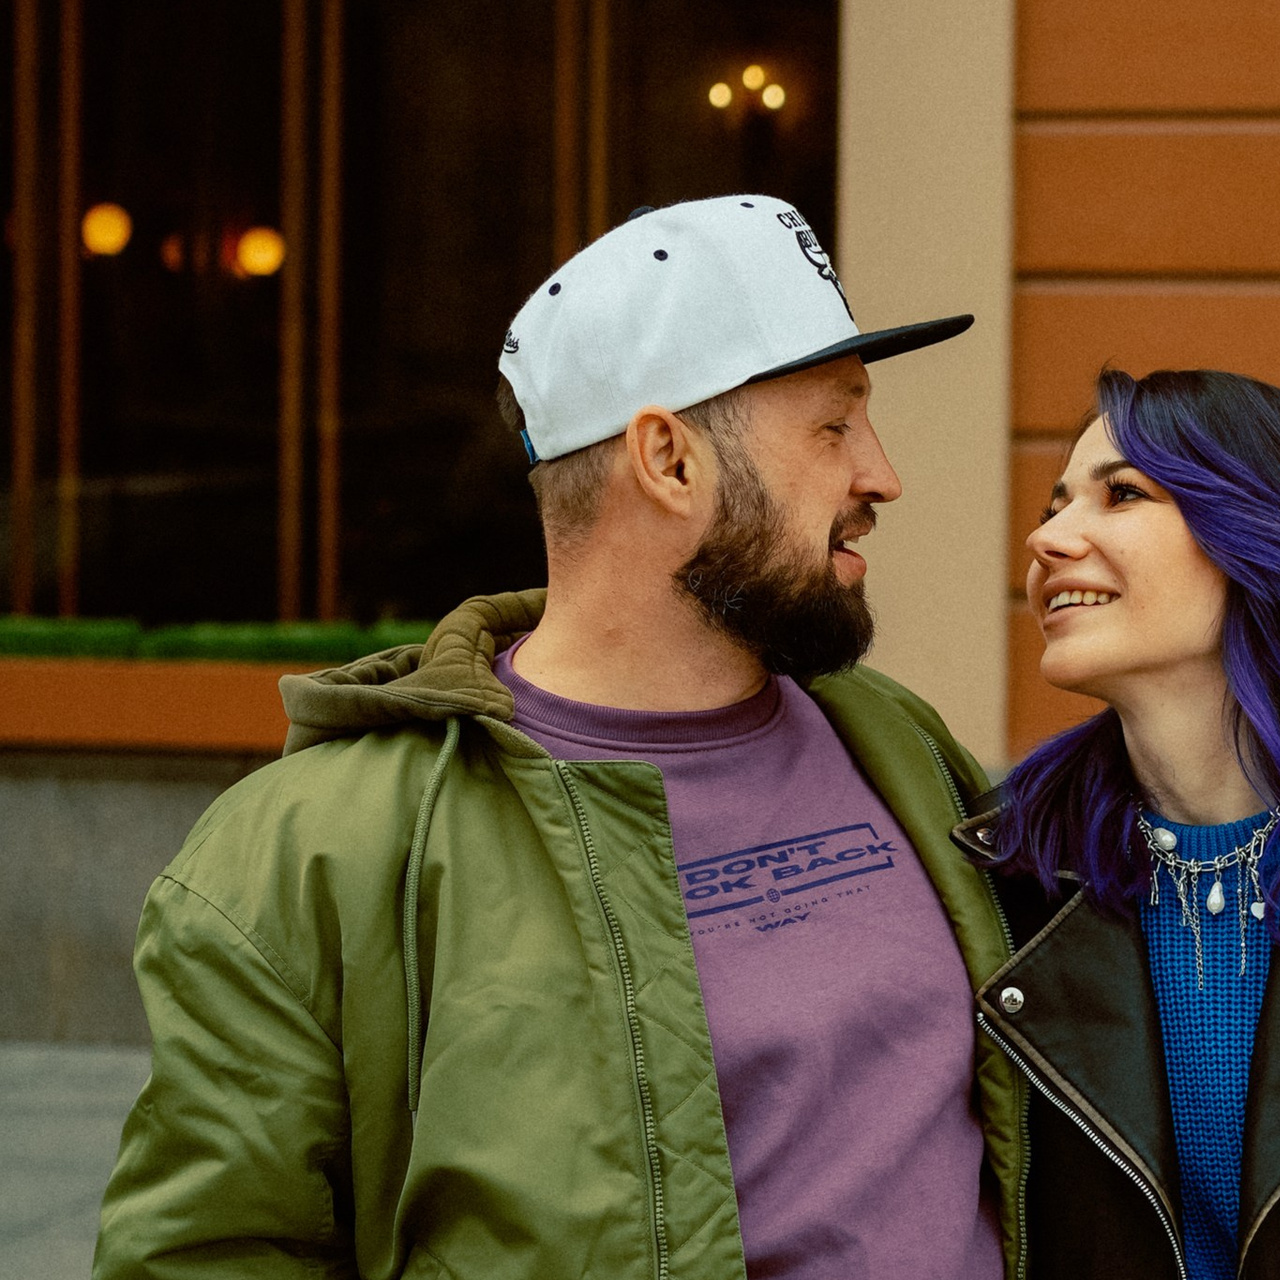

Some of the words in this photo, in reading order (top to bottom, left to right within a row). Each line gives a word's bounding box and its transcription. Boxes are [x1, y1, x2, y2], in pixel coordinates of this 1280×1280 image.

[685, 841, 826, 886] DON'T
[685, 875, 757, 899] OK
[772, 841, 898, 880] BACK
[749, 911, 775, 924] NOT
[836, 885, 870, 898] THAT
[755, 911, 811, 932] WAY
